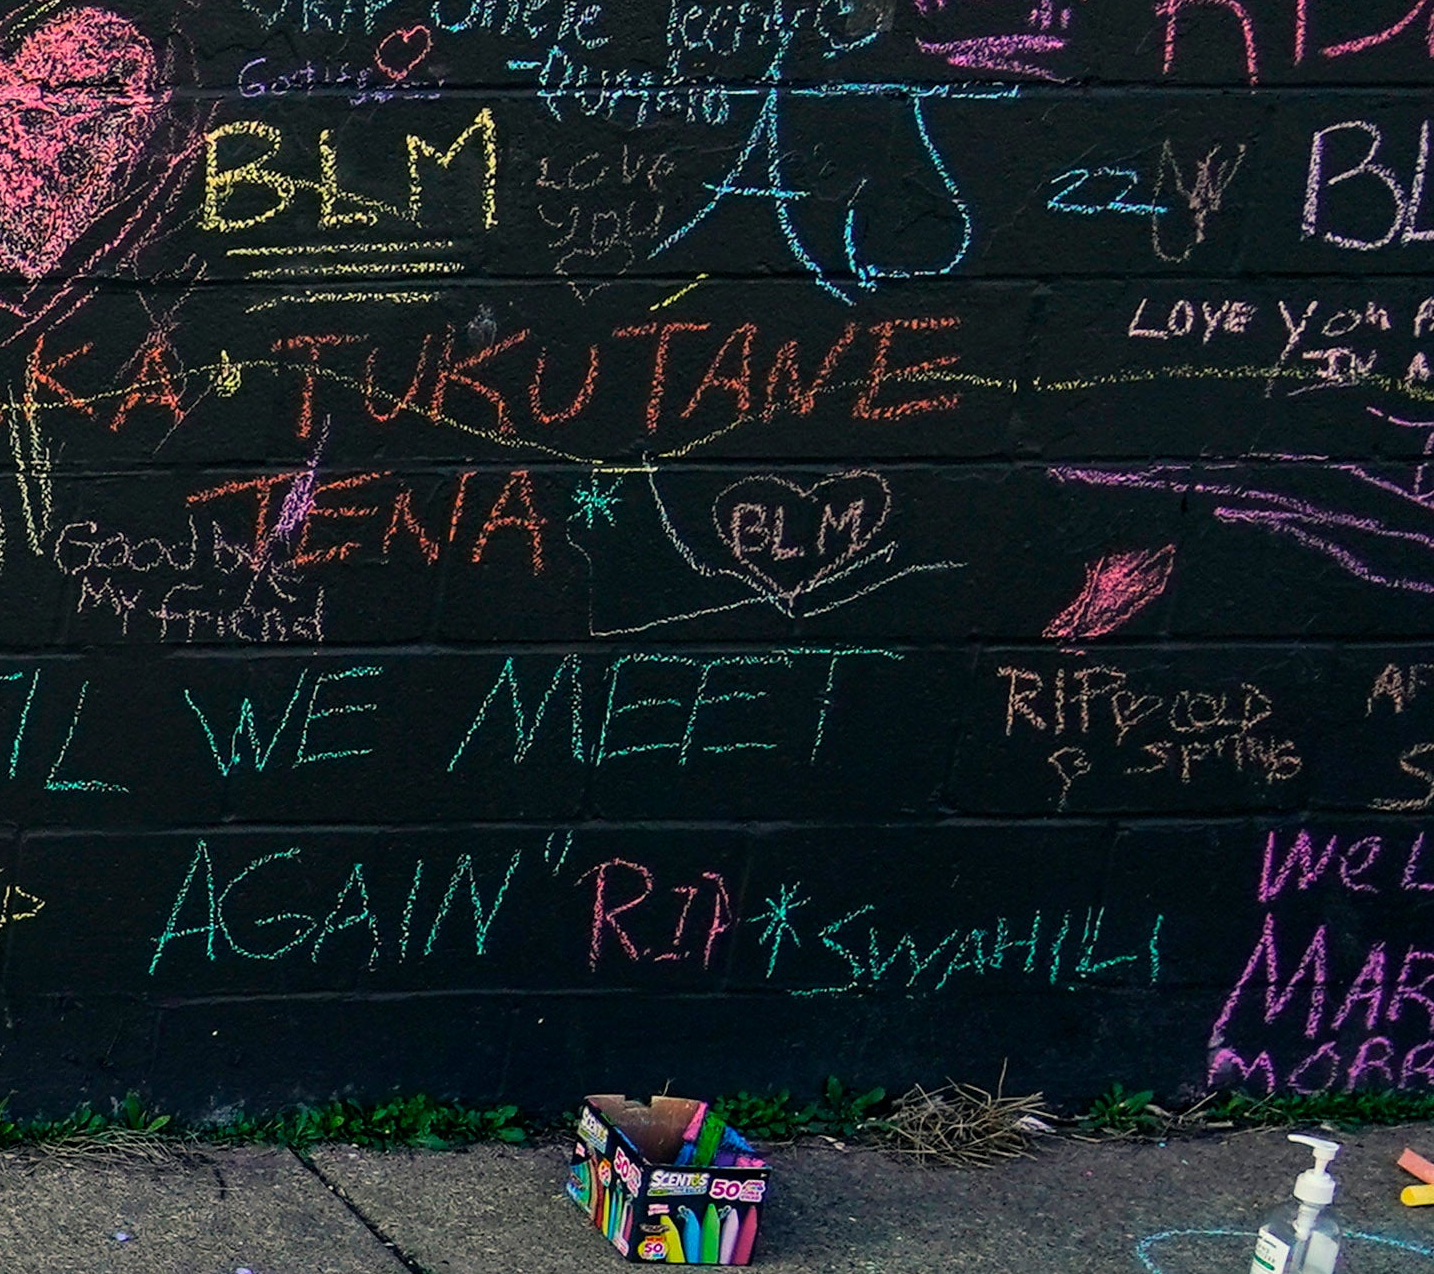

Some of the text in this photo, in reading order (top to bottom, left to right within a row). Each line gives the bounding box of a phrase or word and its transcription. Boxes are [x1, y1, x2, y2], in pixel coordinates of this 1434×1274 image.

[195, 105, 499, 234] BLM
[727, 498, 867, 562] BLM
[184, 666, 384, 777] WE
[446, 646, 905, 772] MEET
[574, 857, 730, 973] RIP
[711, 1180, 740, 1199] 50
[644, 1243, 663, 1253] 50
